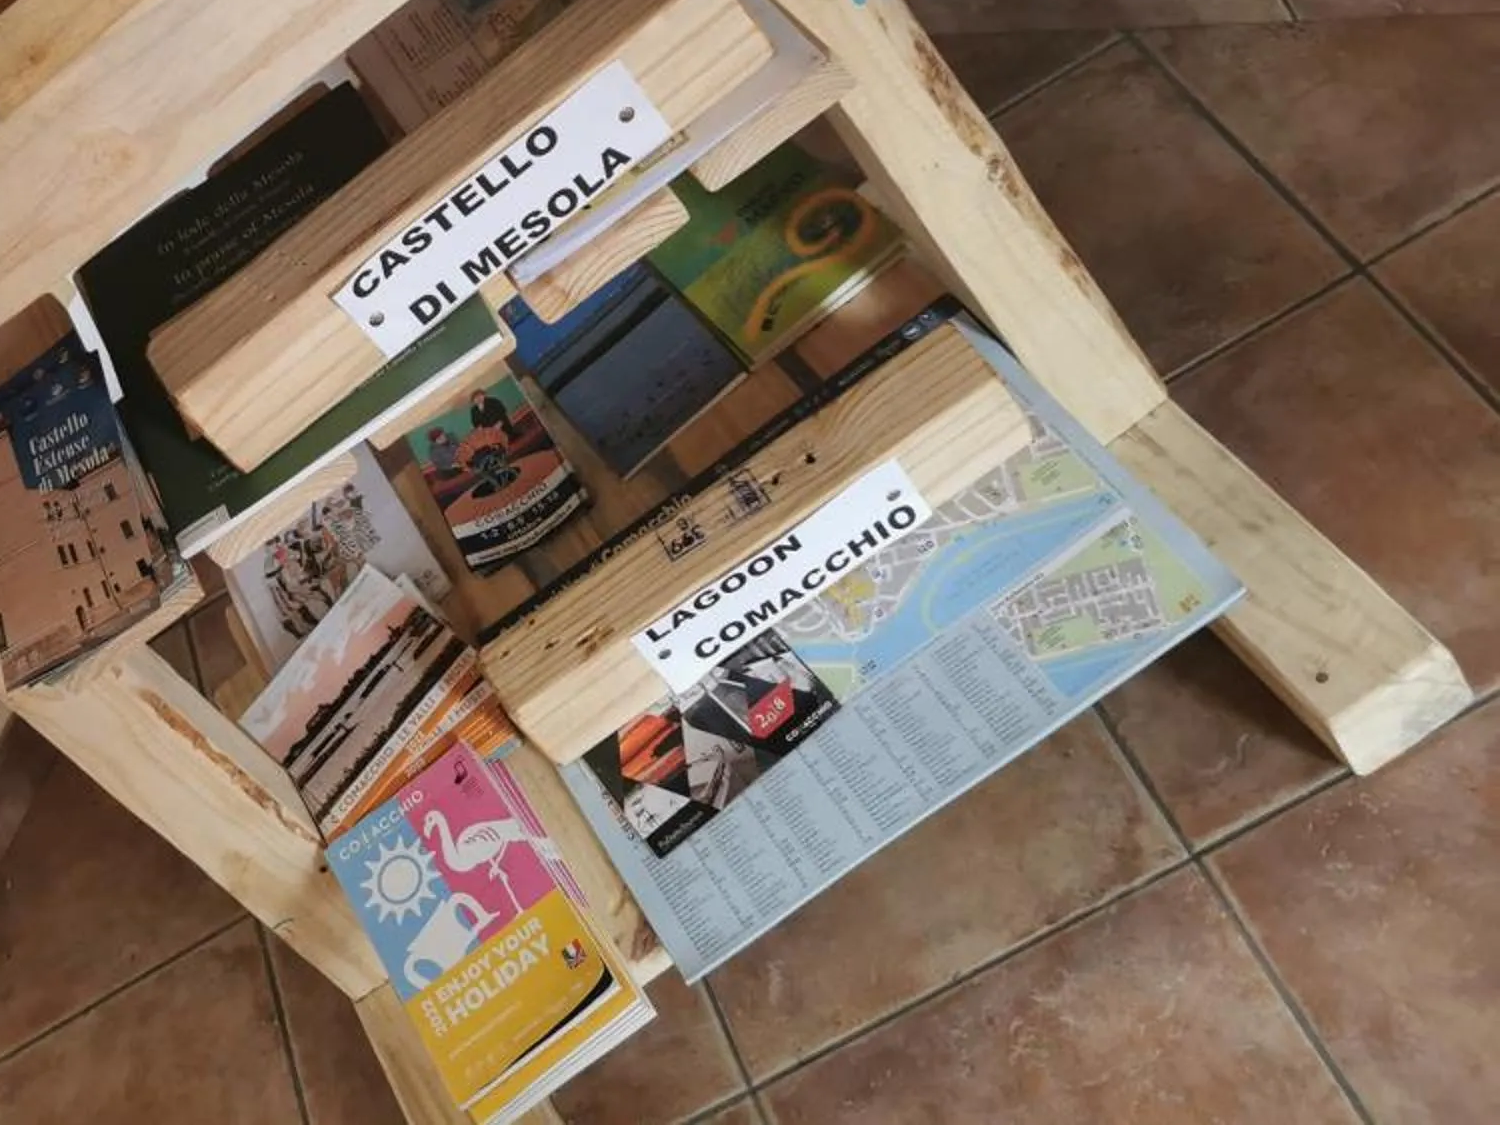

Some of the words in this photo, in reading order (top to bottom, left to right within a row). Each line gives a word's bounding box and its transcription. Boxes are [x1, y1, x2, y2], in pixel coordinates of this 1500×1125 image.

[352, 125, 559, 300] CASTELLO
[408, 282, 458, 326] DI
[461, 146, 632, 285] MESOLA
[28, 410, 90, 455] Castello
[32, 434, 92, 476] Estense
[38, 475, 55, 496] di
[57, 450, 110, 484] Mesola
[645, 534, 803, 643] LAGOON
[694, 503, 917, 660] COMACCHIO
[436, 954, 493, 1005] ENJOY
[488, 916, 544, 958] YOUR
[442, 933, 553, 1027] HOLIDAY
